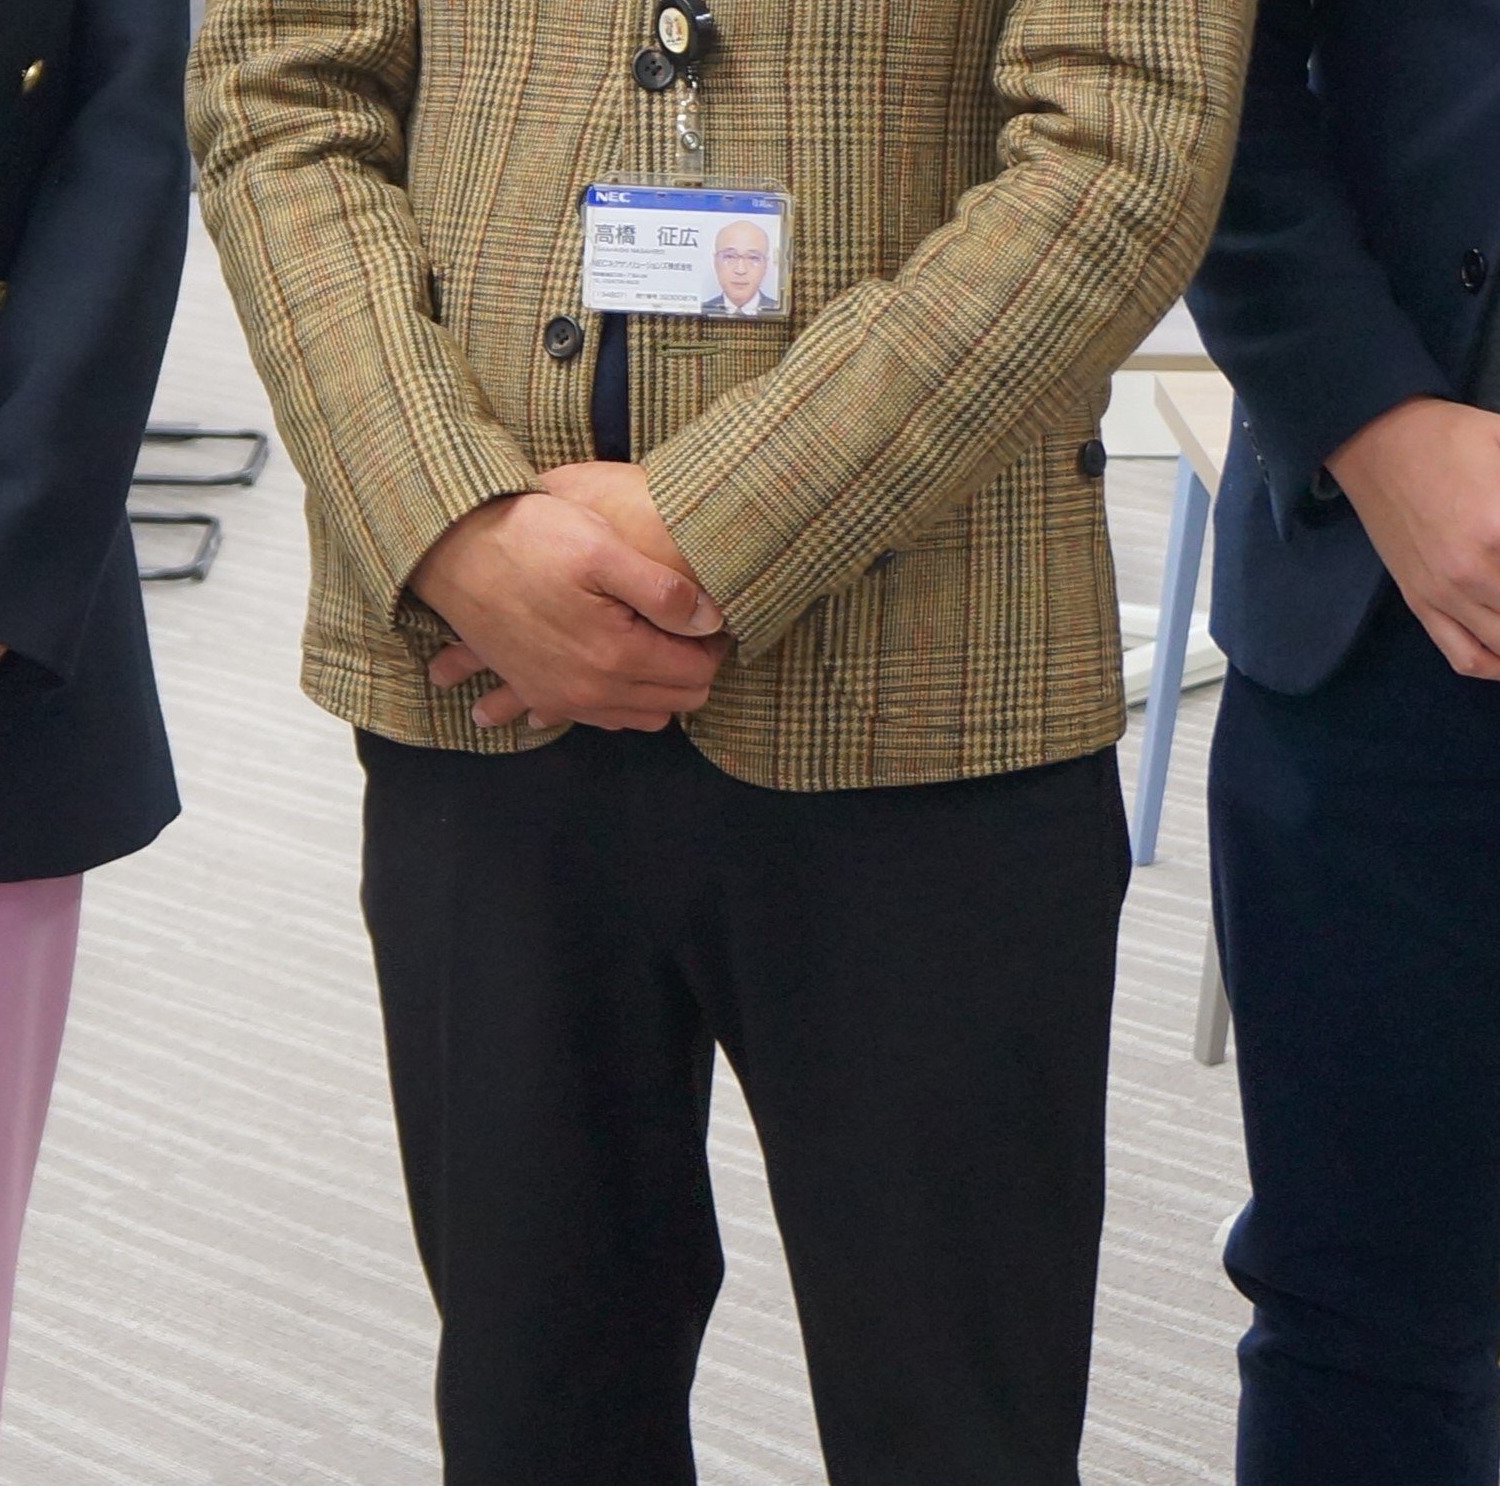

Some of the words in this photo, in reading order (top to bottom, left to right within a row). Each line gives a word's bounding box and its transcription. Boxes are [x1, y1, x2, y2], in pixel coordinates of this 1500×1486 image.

[595, 191, 631, 203] NEC
[594, 223, 636, 245] 高橋
[657, 226, 699, 248] 征広
